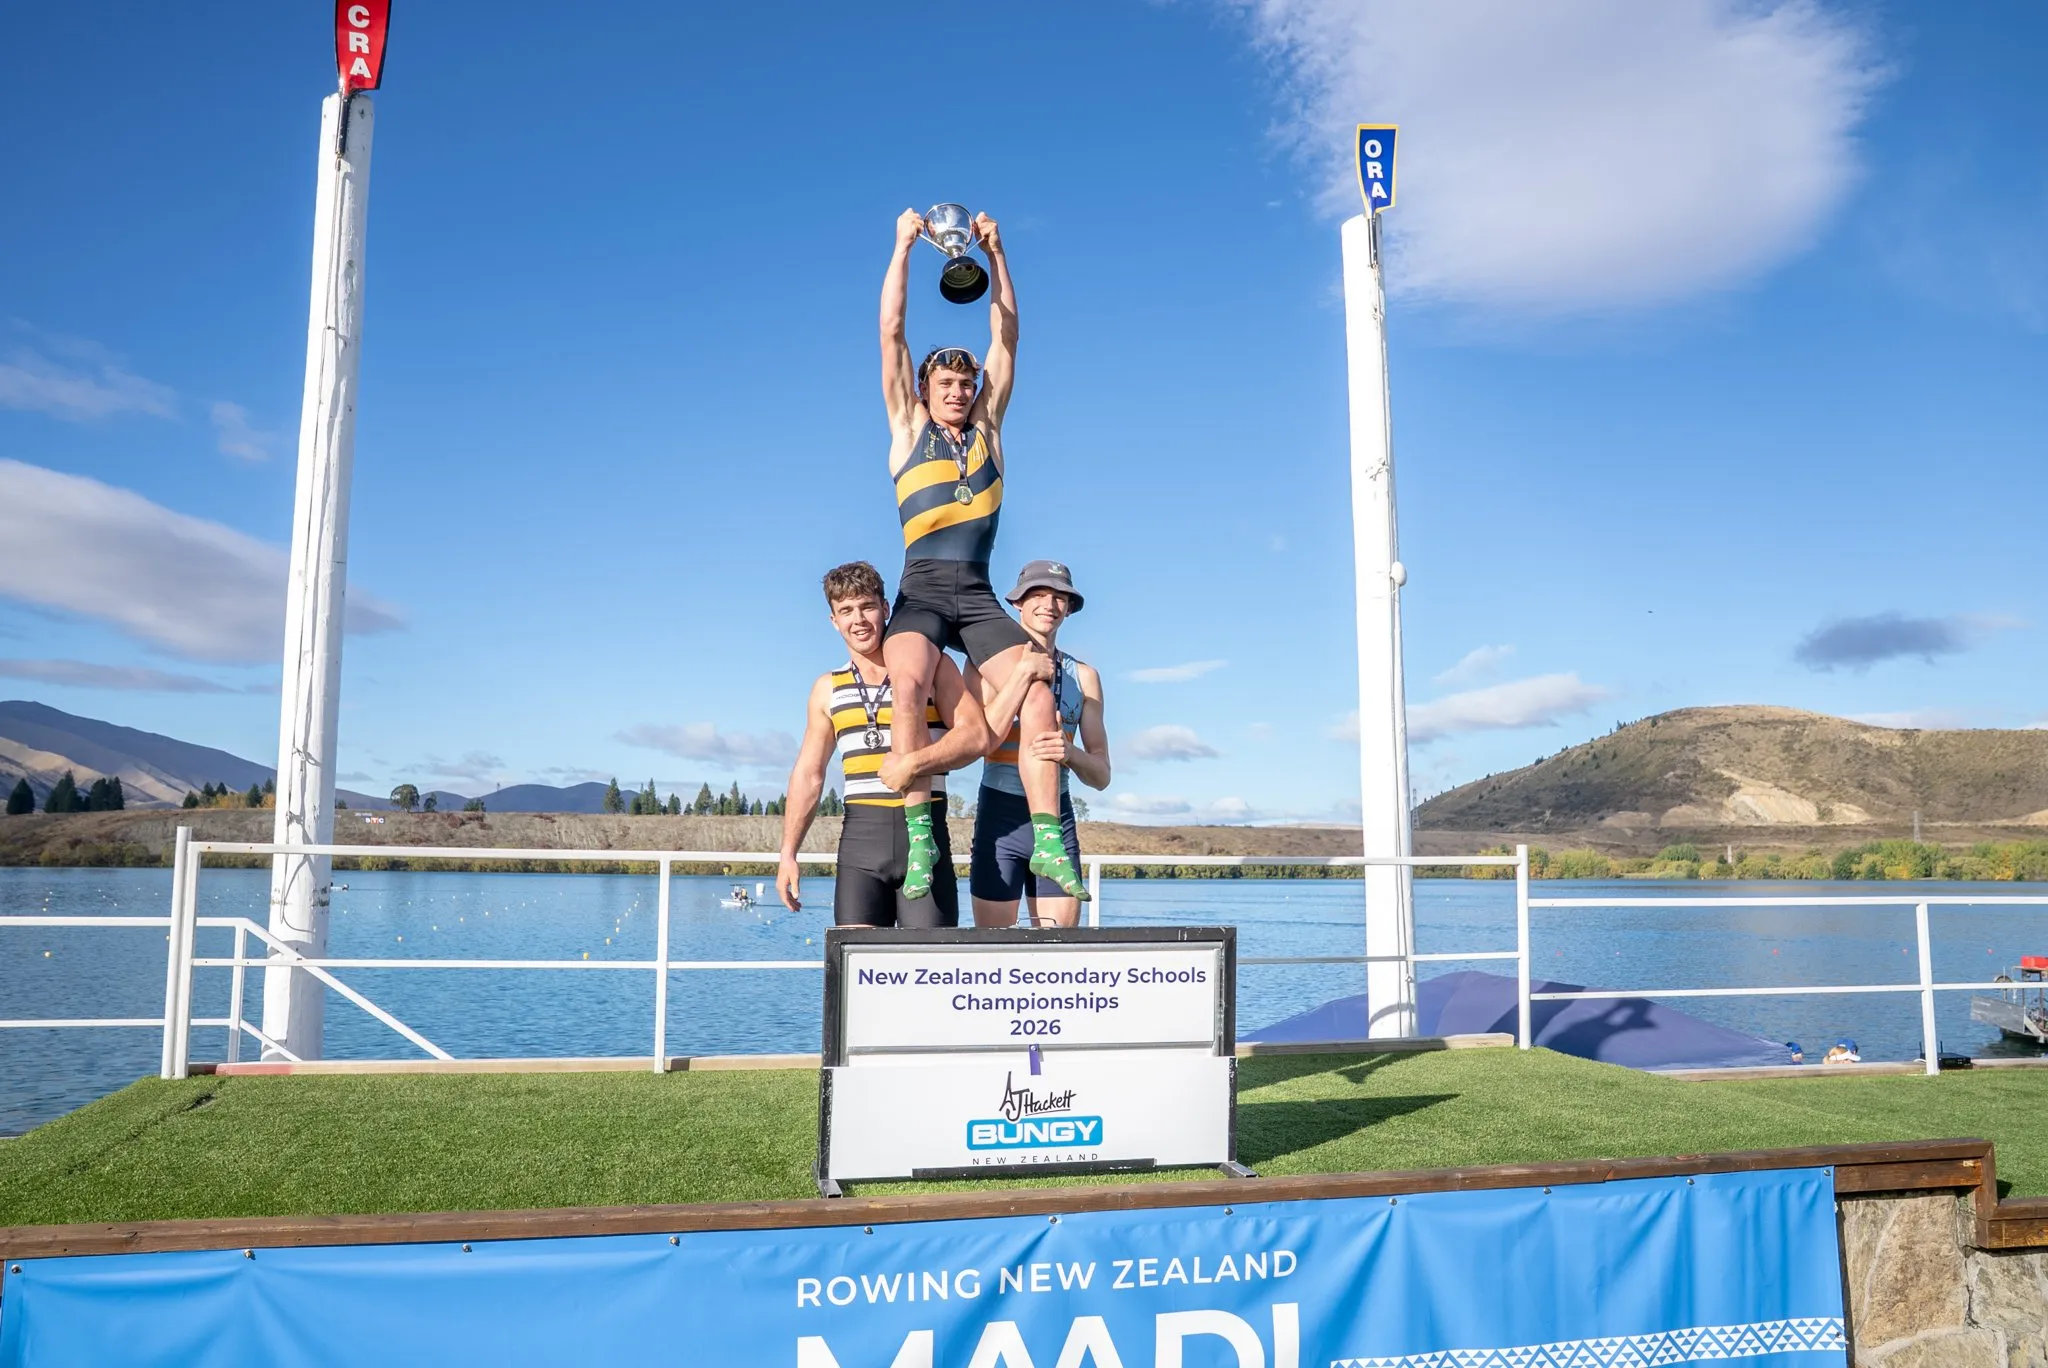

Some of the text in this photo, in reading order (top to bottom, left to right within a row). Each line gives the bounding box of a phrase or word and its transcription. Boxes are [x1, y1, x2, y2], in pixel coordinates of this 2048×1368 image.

[347, 4, 372, 79] CRA
[1364, 139, 1388, 199] ORA
[858, 966, 1207, 988] New Zealand Secondary Schools
[951, 992, 1119, 1015] Championships
[1010, 1019, 1062, 1036] 2026
[1023, 1089, 1077, 1115] Hackett
[972, 1119, 1099, 1146] BUNGY
[972, 1153, 1099, 1166] NEW ZEALAND
[797, 1249, 1298, 1308] ROWING NEW ZEALAND
